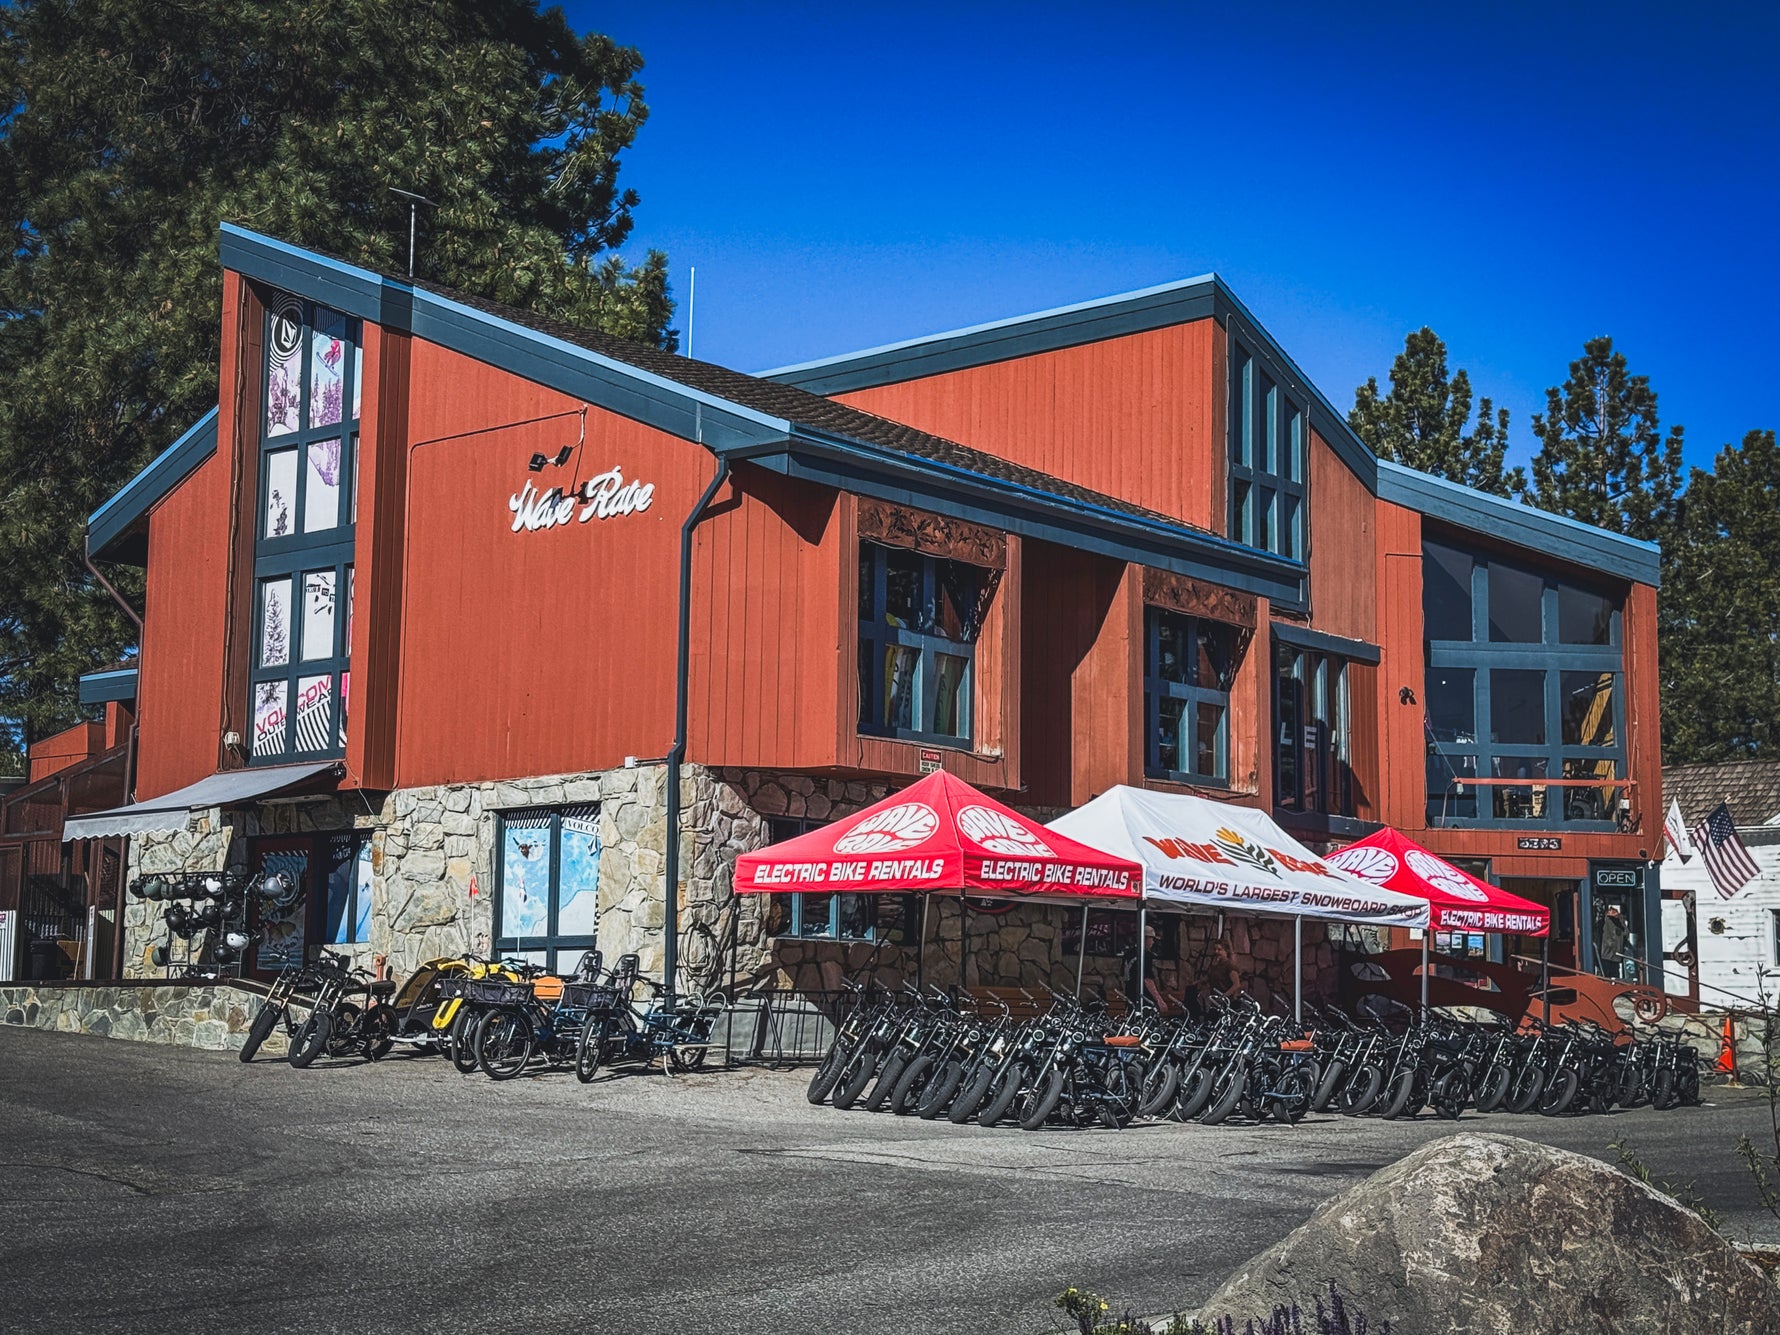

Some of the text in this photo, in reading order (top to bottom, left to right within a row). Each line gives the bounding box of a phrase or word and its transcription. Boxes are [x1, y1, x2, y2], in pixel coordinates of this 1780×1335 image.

[509, 465, 656, 533] Wave Rave
[568, 819, 600, 834] VOLCO
[1143, 836, 1239, 868] WAVE
[753, 859, 944, 884] ELECTRIC BIKE RENTALS
[980, 860, 1130, 890] ELECTRIC BIKE RENTALS
[1599, 873, 1634, 884] OPEN
[1159, 874, 1422, 918] WORLD'S LARGEST SNOWBOARD SHOP
[1440, 909, 1543, 931] ELECTRIC BIKE RENTALS
